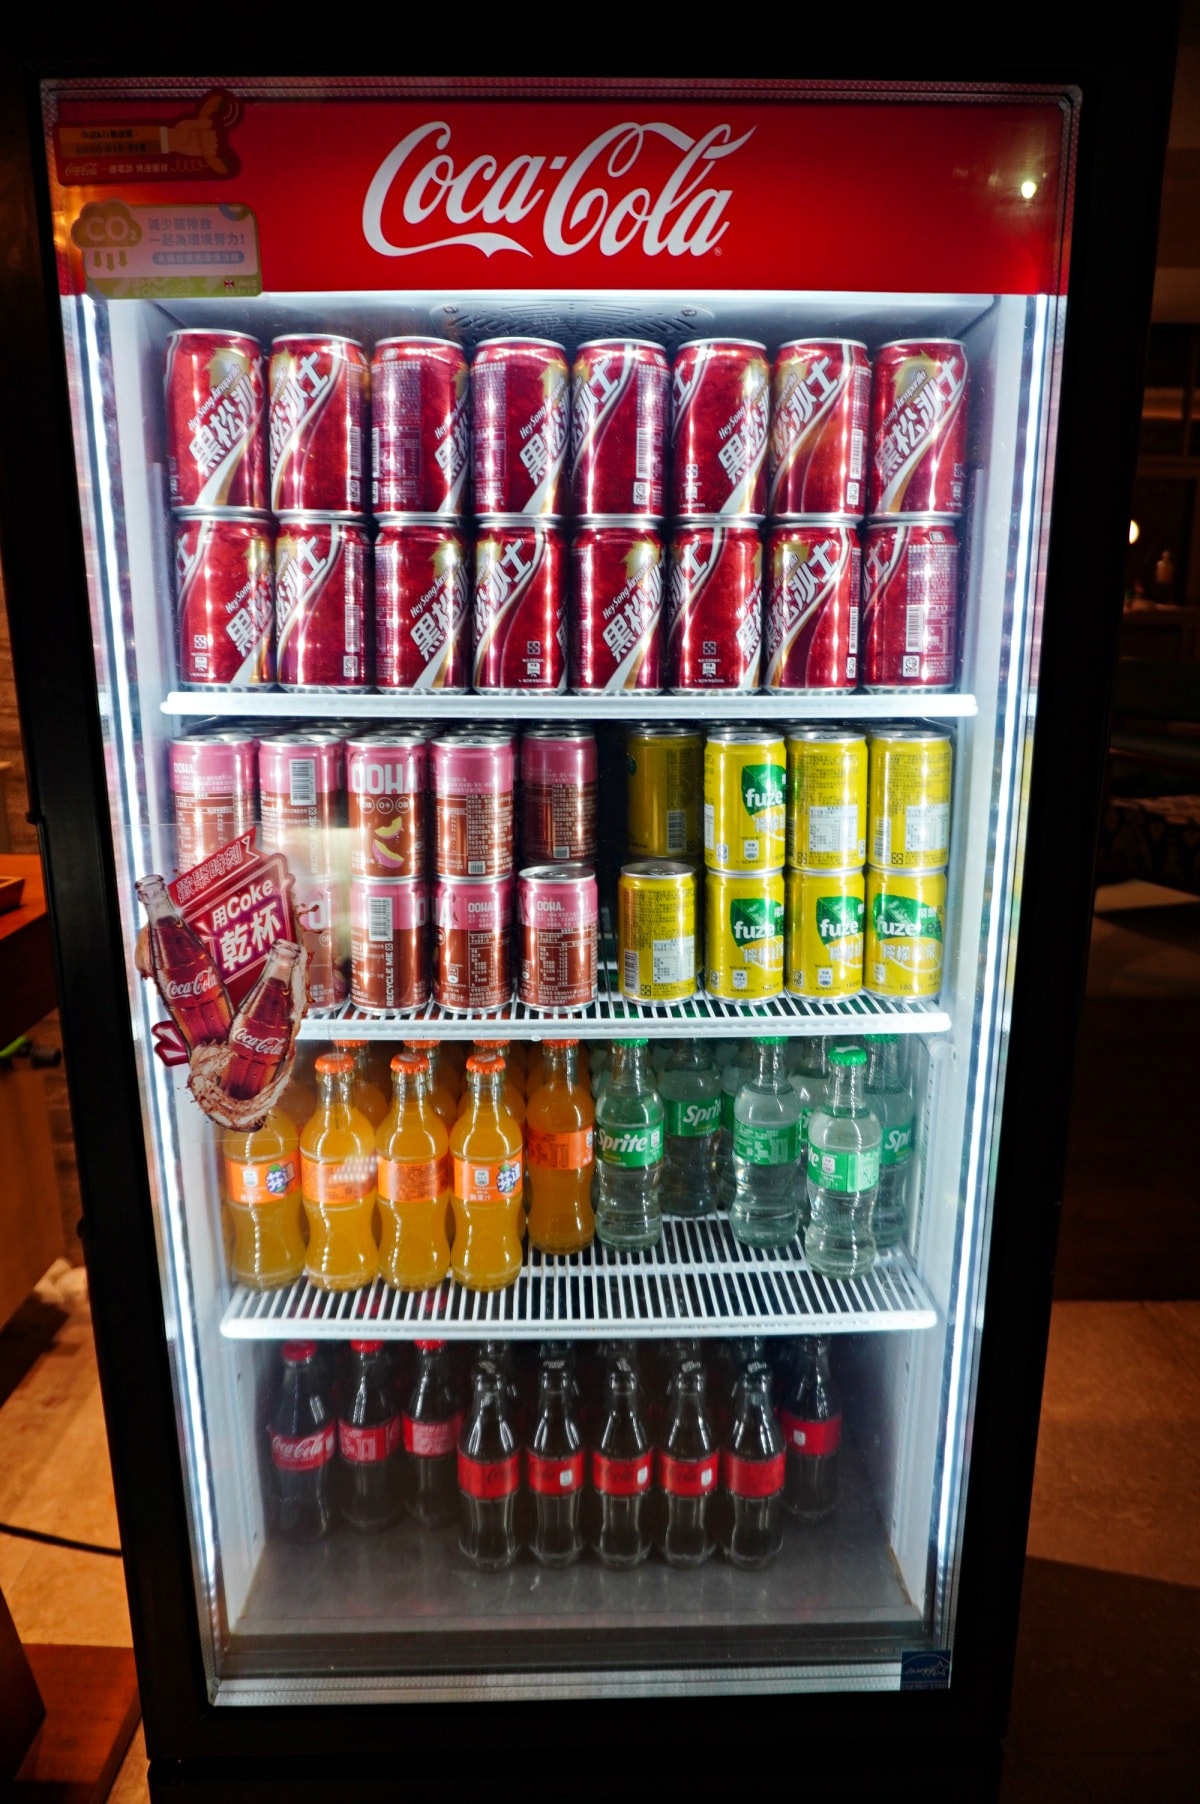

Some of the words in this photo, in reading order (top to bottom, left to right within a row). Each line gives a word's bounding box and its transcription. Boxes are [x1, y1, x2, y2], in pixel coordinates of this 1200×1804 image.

[363, 121, 757, 258] Coca-Cola
[745, 787, 783, 807] fuze
[219, 901, 282, 972] 乾杯
[733, 920, 775, 940] fuze
[819, 918, 859, 937] fuze
[385, 952, 394, 966] ME
[166, 966, 218, 999] Coca-Cola
[233, 1027, 287, 1055] Coca-Cola
[598, 1128, 648, 1152] Sprite
